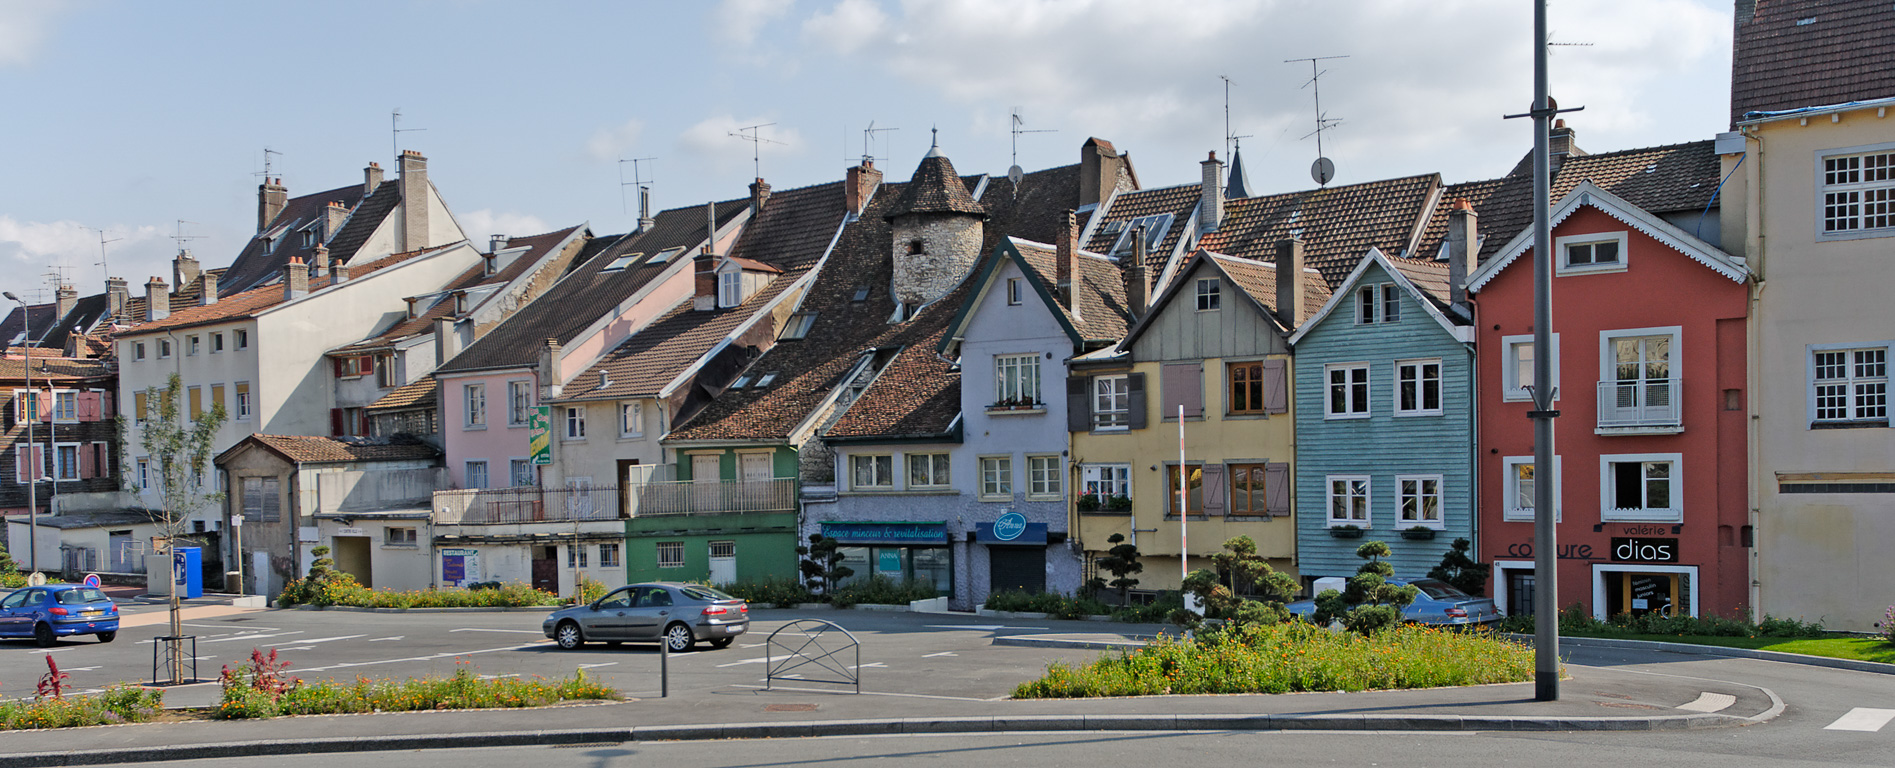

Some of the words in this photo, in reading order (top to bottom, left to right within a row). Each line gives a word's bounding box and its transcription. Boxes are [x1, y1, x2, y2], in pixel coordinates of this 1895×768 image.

[998, 517, 1022, 530] Anna
[1623, 525, 1666, 535] valérie
[821, 524, 849, 538] Espace
[851, 529, 881, 538] minceur
[883, 527, 892, 538] &
[893, 526, 943, 538] revitalisation
[1508, 543, 1594, 559] coure
[1616, 539, 1671, 560] dias
[1634, 583, 1657, 592] masculin
[1637, 591, 1654, 599] juniors
